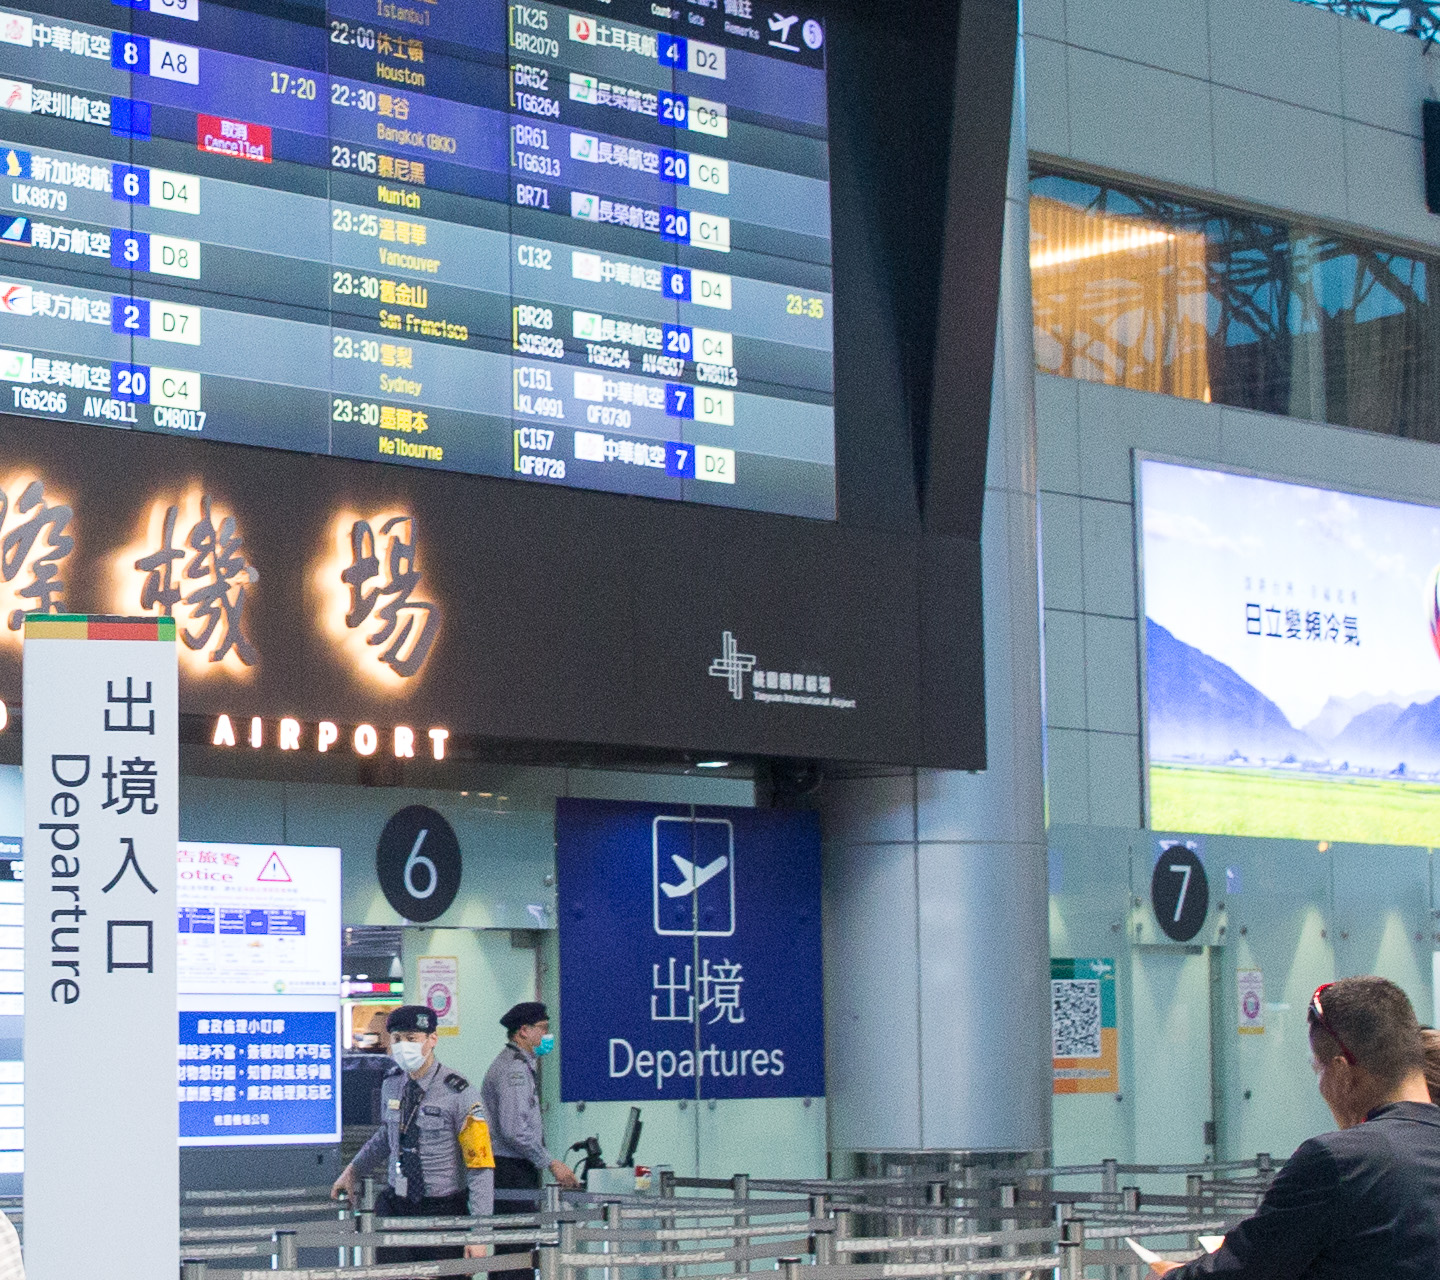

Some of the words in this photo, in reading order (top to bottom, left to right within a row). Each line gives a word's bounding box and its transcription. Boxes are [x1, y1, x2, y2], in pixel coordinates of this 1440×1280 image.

[514, 4, 548, 32] TK25
[696, 50, 718, 71] D2
[331, 83, 376, 112] 22:30
[204, 134, 265, 160] Cancelled
[378, 246, 440, 274] Vancouver
[378, 435, 443, 462] Melbourne
[1246, 603, 1360, 646] 日立變頻冷氣
[214, 714, 449, 761] AIRPORT
[102, 676, 159, 975] 出境入口
[39, 753, 91, 1006] Departure
[181, 870, 233, 883] otice
[404, 828, 437, 900] 6
[1167, 866, 1191, 921] 7
[650, 957, 746, 1026] 出境
[608, 1039, 784, 1084] Departures
